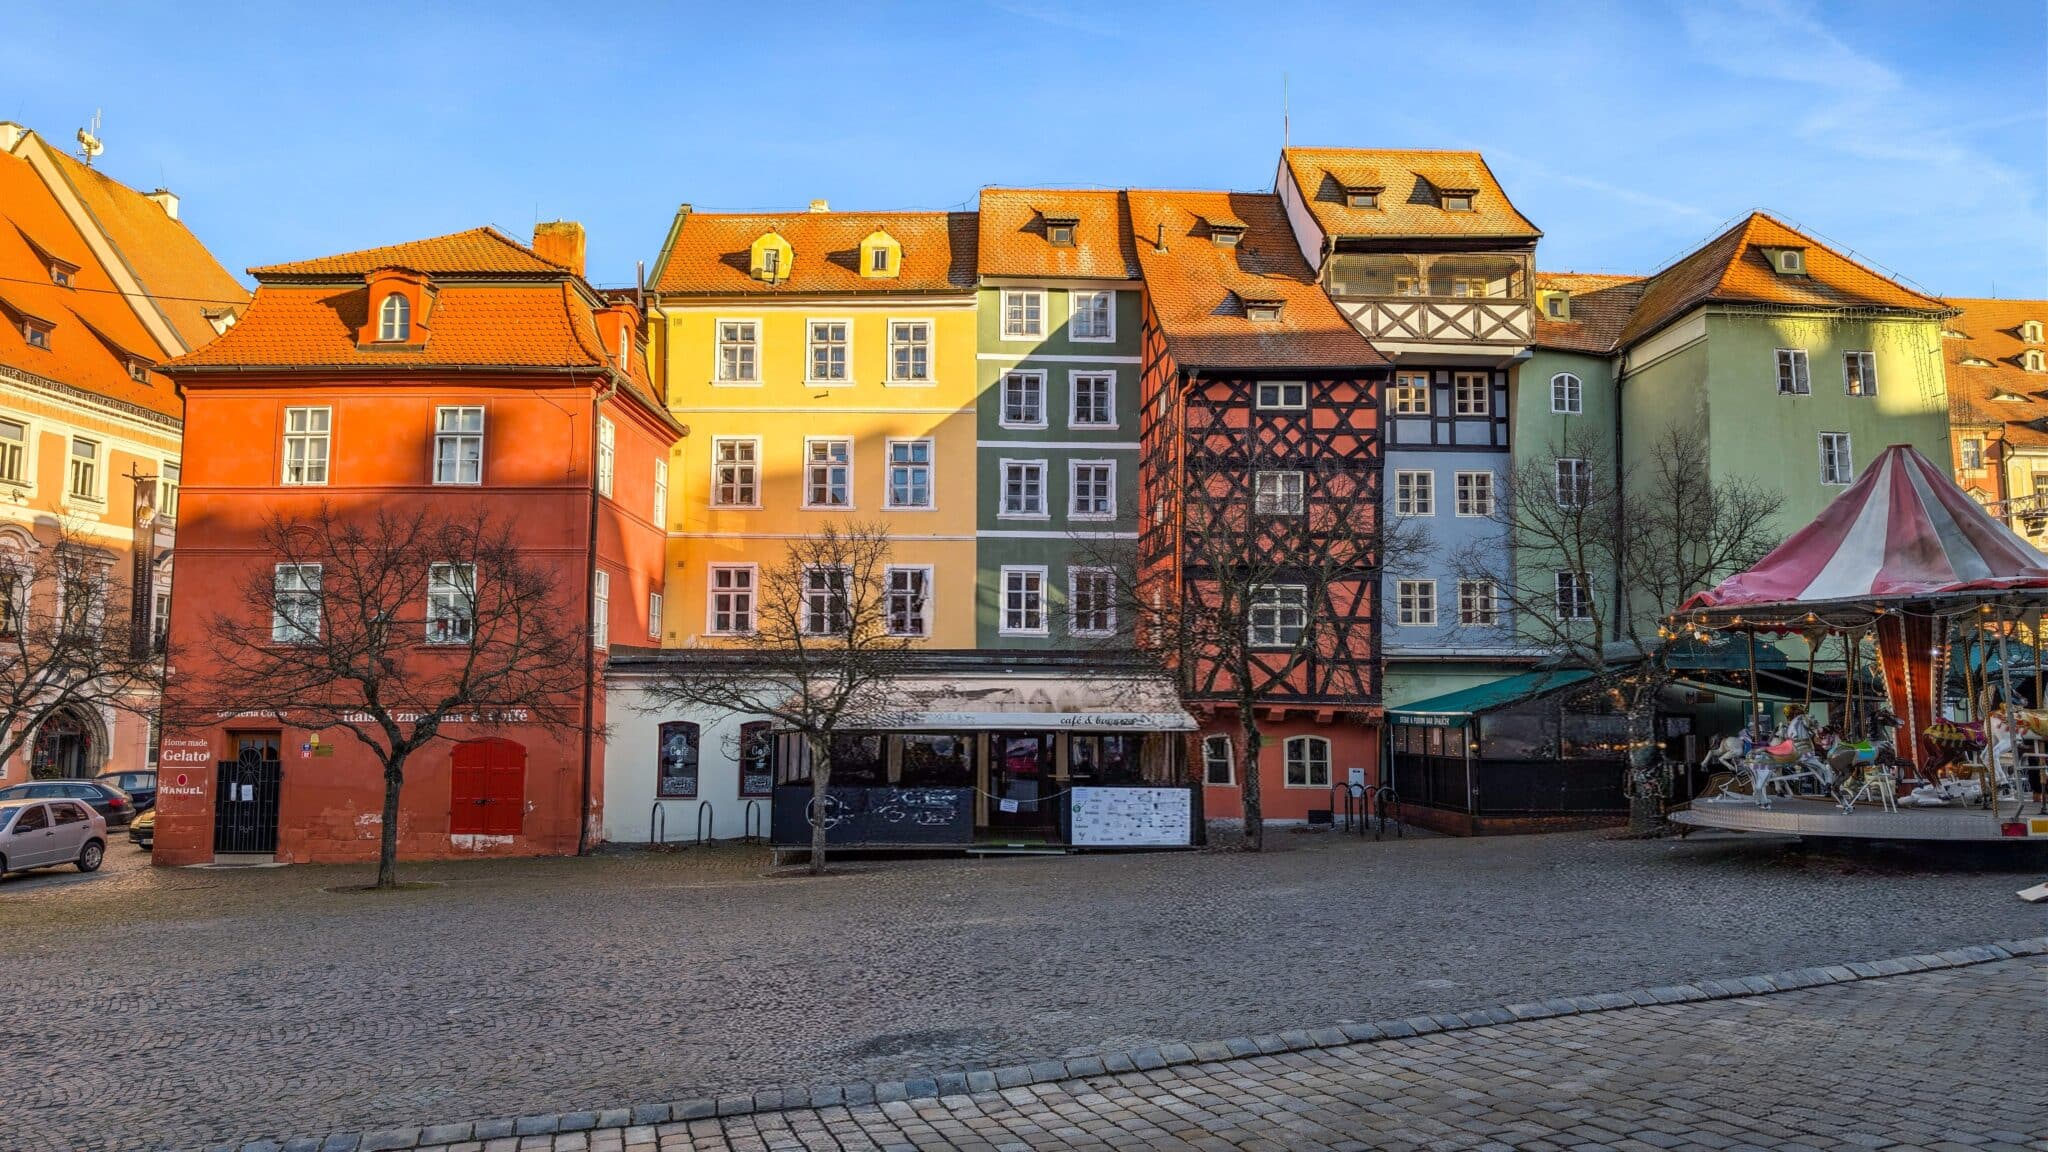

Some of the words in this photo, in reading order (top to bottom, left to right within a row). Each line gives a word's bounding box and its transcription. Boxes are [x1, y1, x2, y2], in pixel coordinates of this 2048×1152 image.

[164, 738, 186, 746] Home
[187, 738, 208, 747] made
[163, 749, 207, 762] Gelato
